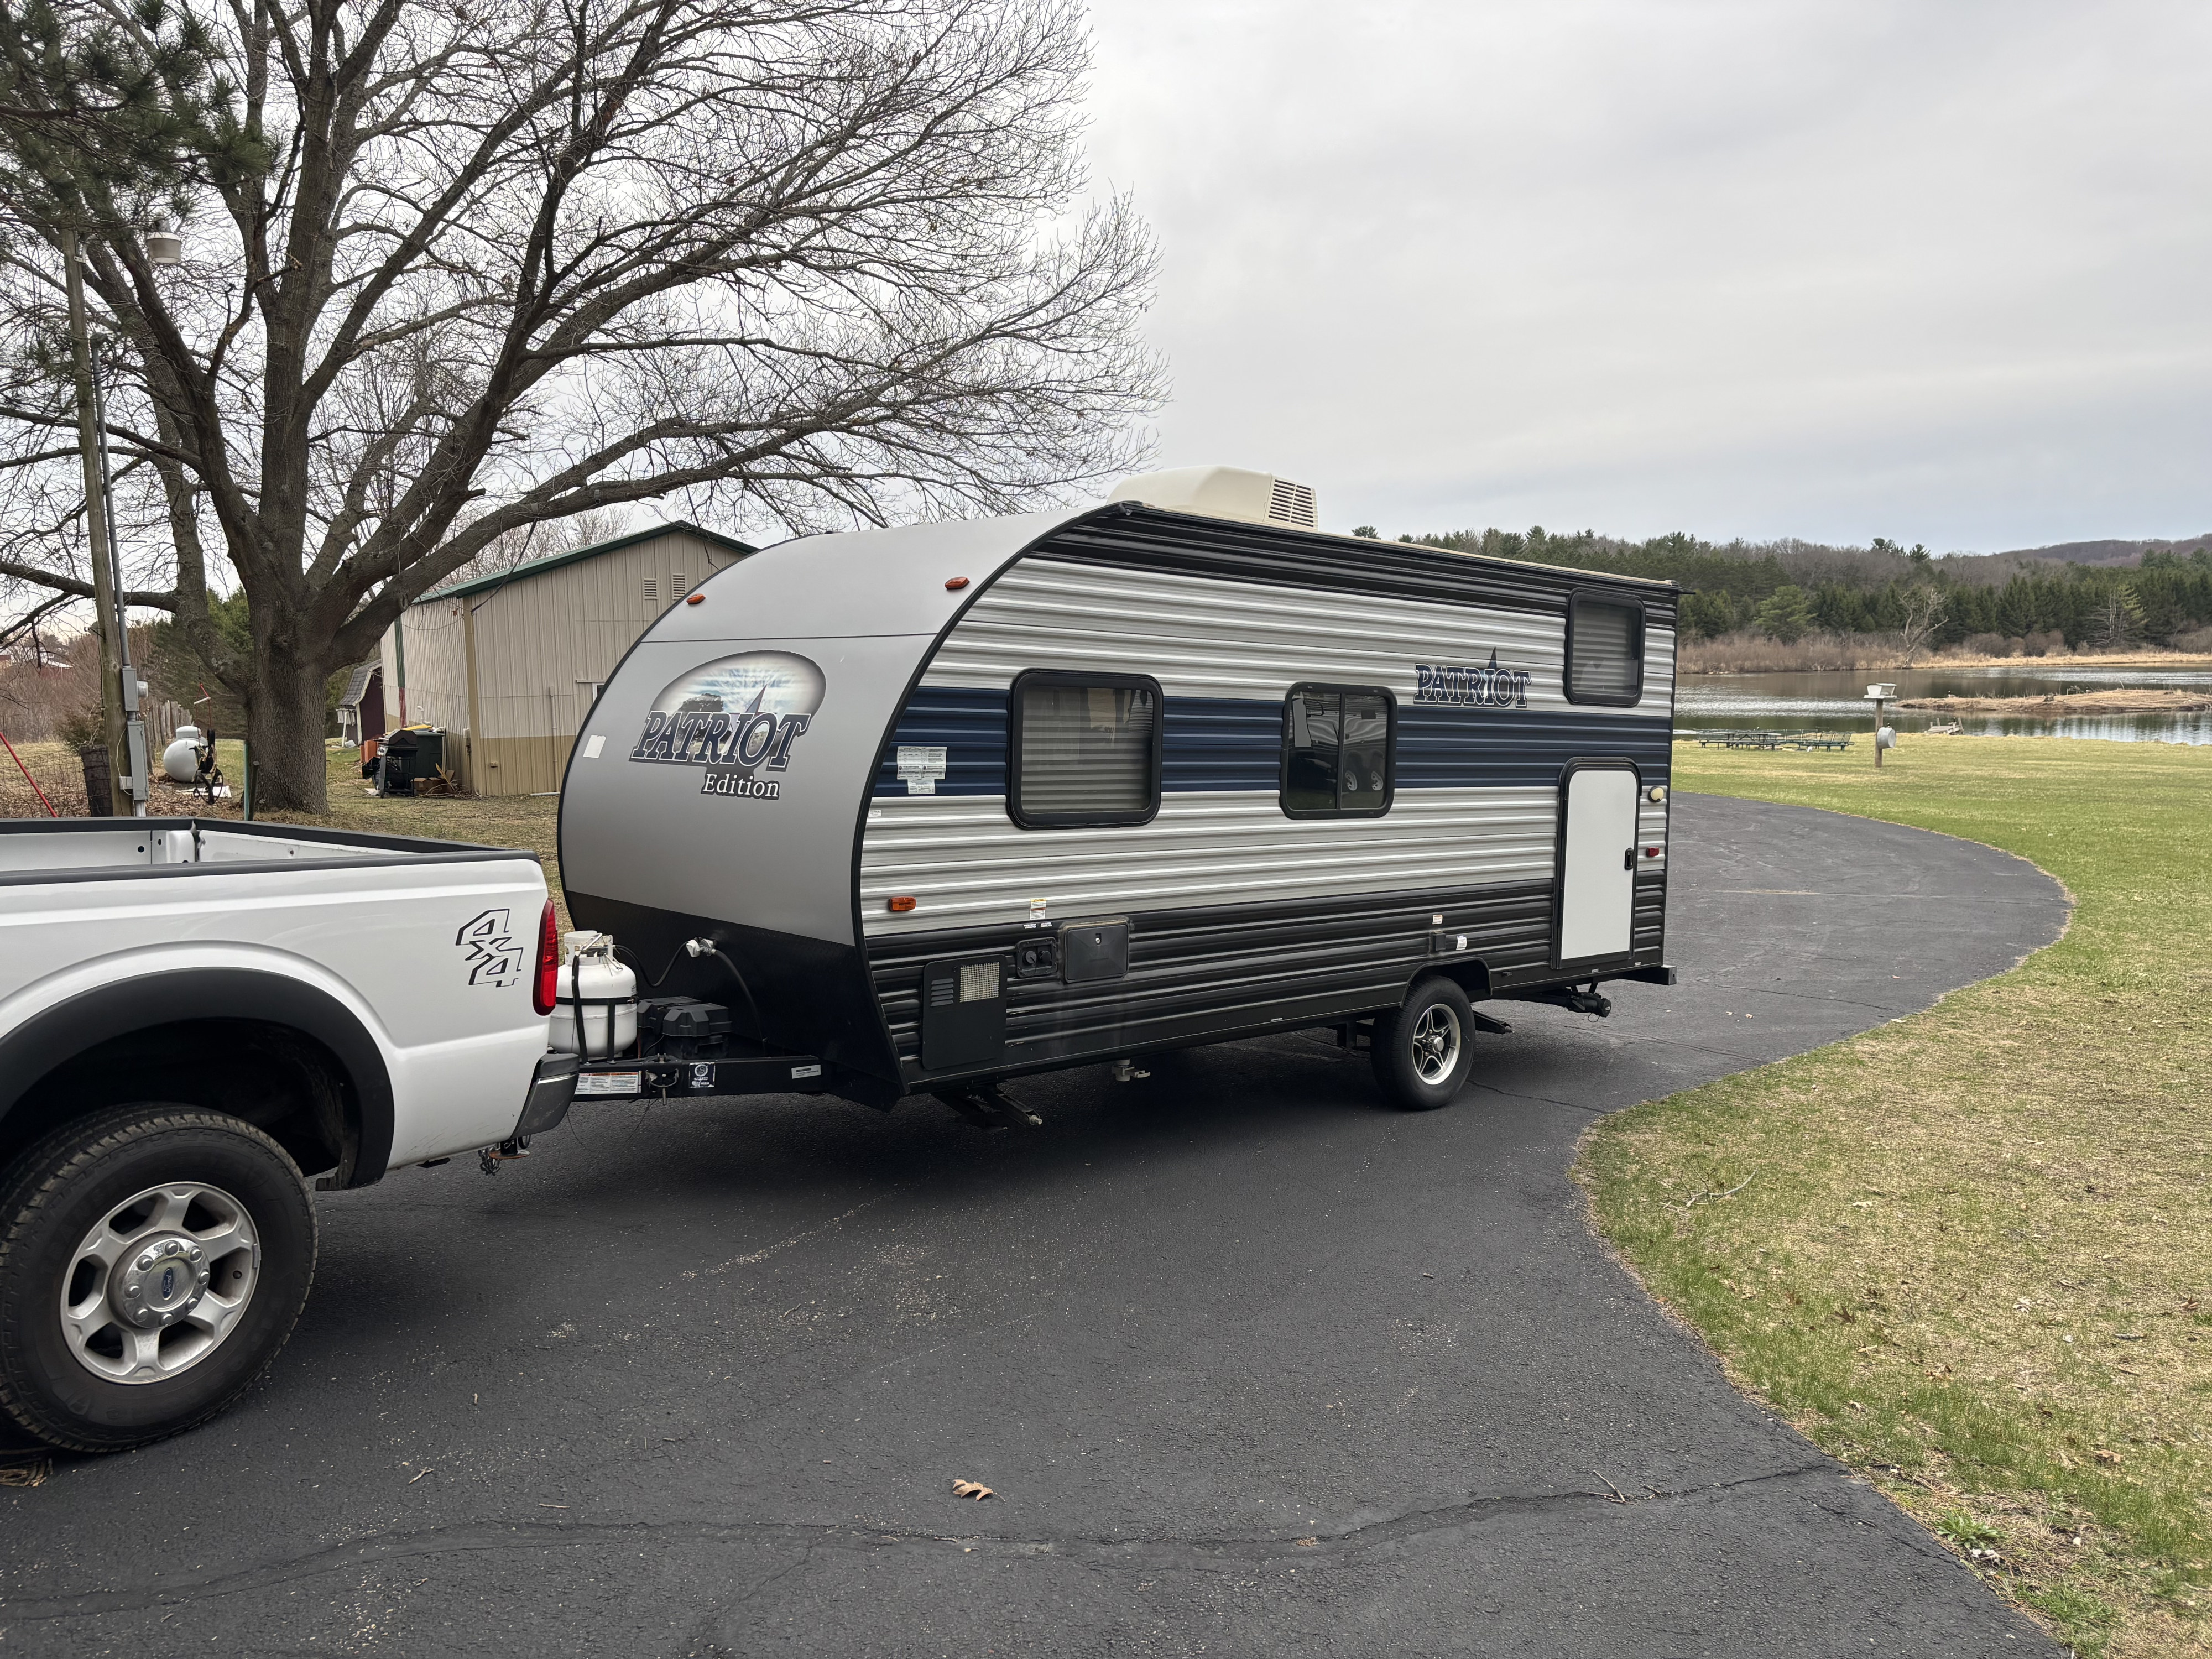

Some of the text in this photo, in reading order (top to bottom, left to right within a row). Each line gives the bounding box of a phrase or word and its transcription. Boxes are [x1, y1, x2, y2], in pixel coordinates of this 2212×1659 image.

[1413, 663, 1531, 708] PATRIOT
[630, 710, 812, 768] PATRIOT
[702, 773, 779, 797] Edition
[163, 1274, 173, 1294] Ford
